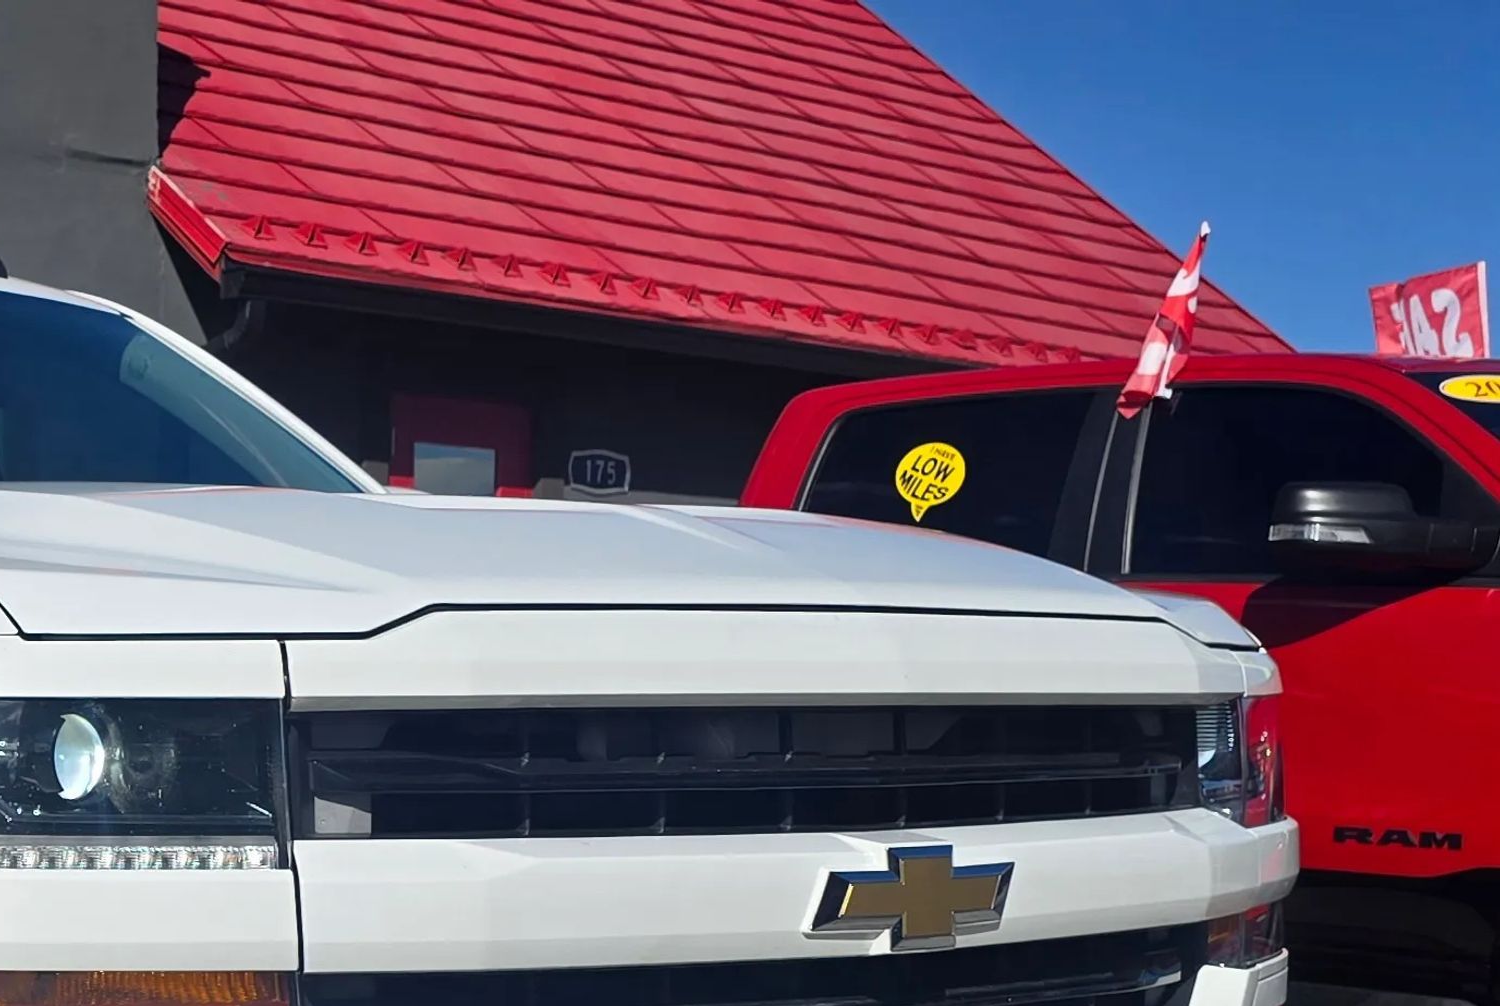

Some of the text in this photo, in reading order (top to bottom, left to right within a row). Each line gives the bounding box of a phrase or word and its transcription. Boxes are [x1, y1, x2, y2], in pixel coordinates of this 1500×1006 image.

[586, 460, 616, 485] 175
[911, 455, 955, 483] LOW
[899, 469, 949, 502] MILES
[1333, 826, 1463, 851] RAM
